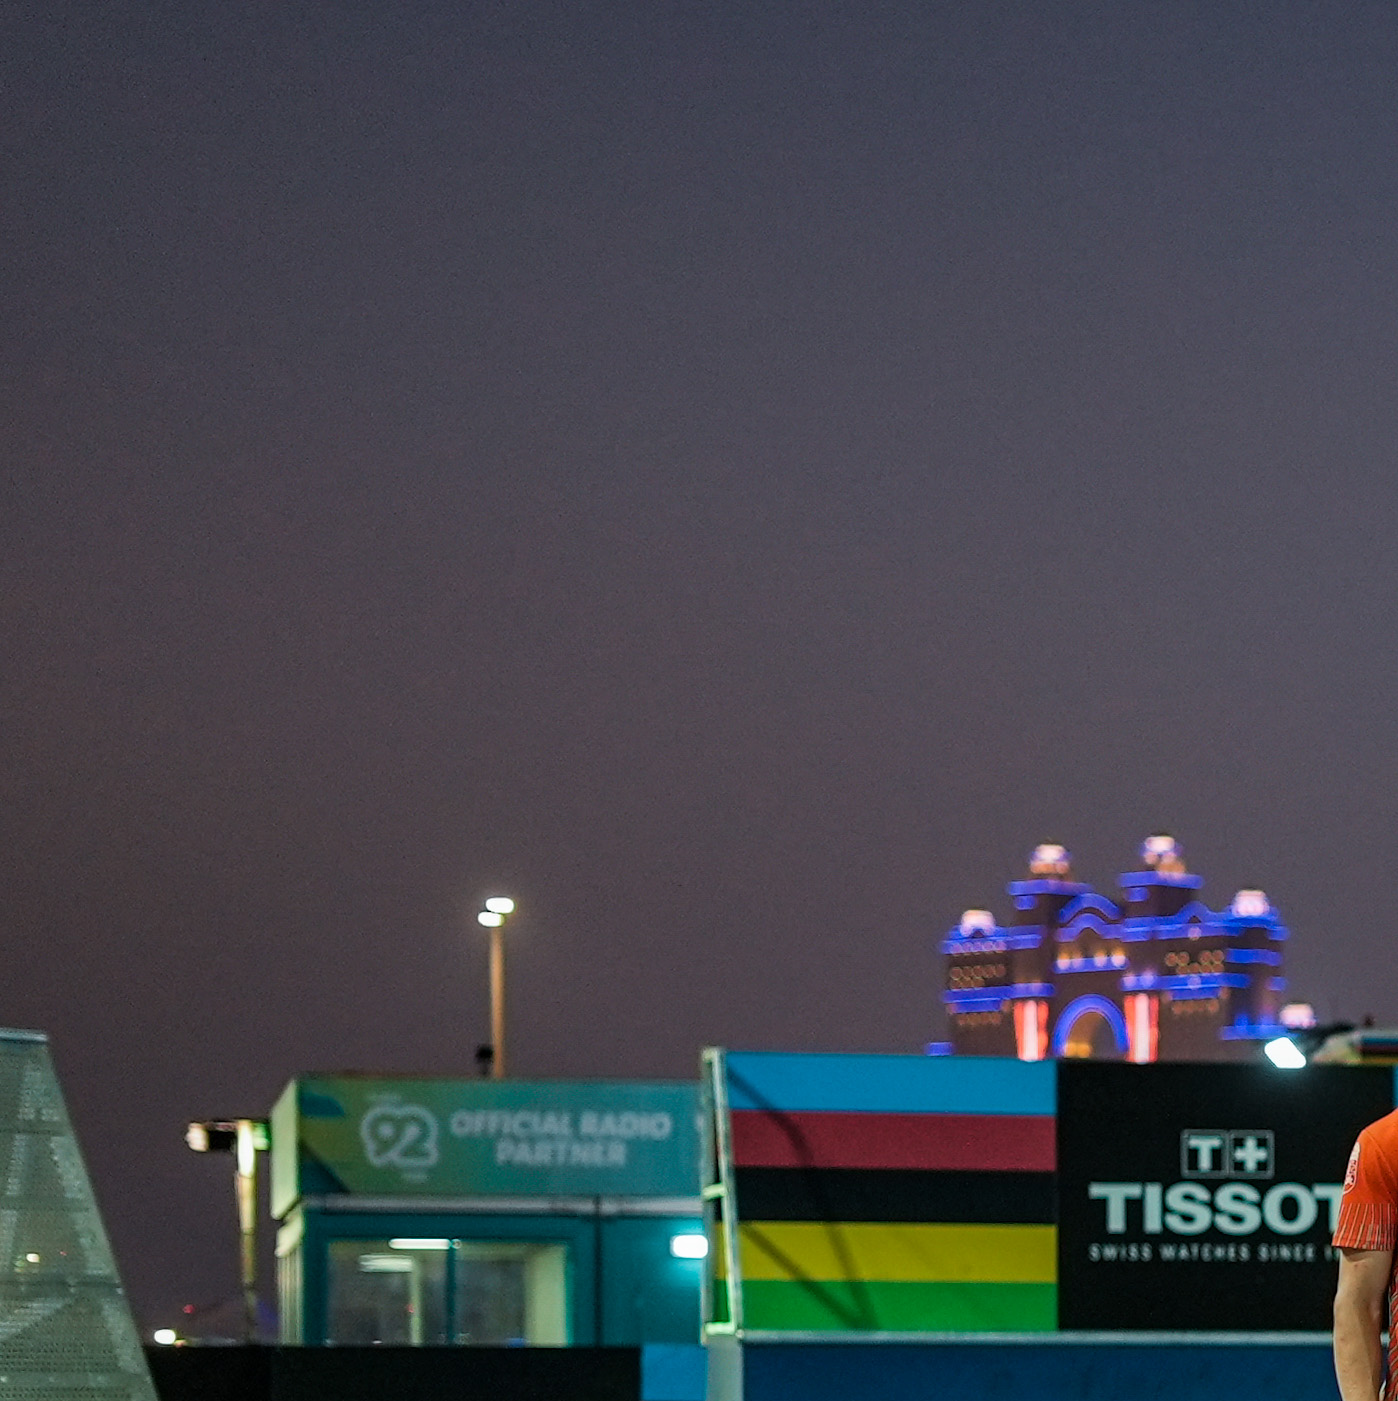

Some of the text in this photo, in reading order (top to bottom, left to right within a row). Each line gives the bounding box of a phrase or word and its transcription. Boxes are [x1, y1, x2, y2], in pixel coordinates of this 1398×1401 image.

[450, 1110, 672, 1141] OFFICIAL RADIO
[495, 1140, 627, 1167] PARTNER
[1088, 1242, 1153, 1262] SWISS
[1158, 1242, 1251, 1262] WATCHES
[1257, 1242, 1316, 1262] SINCE
